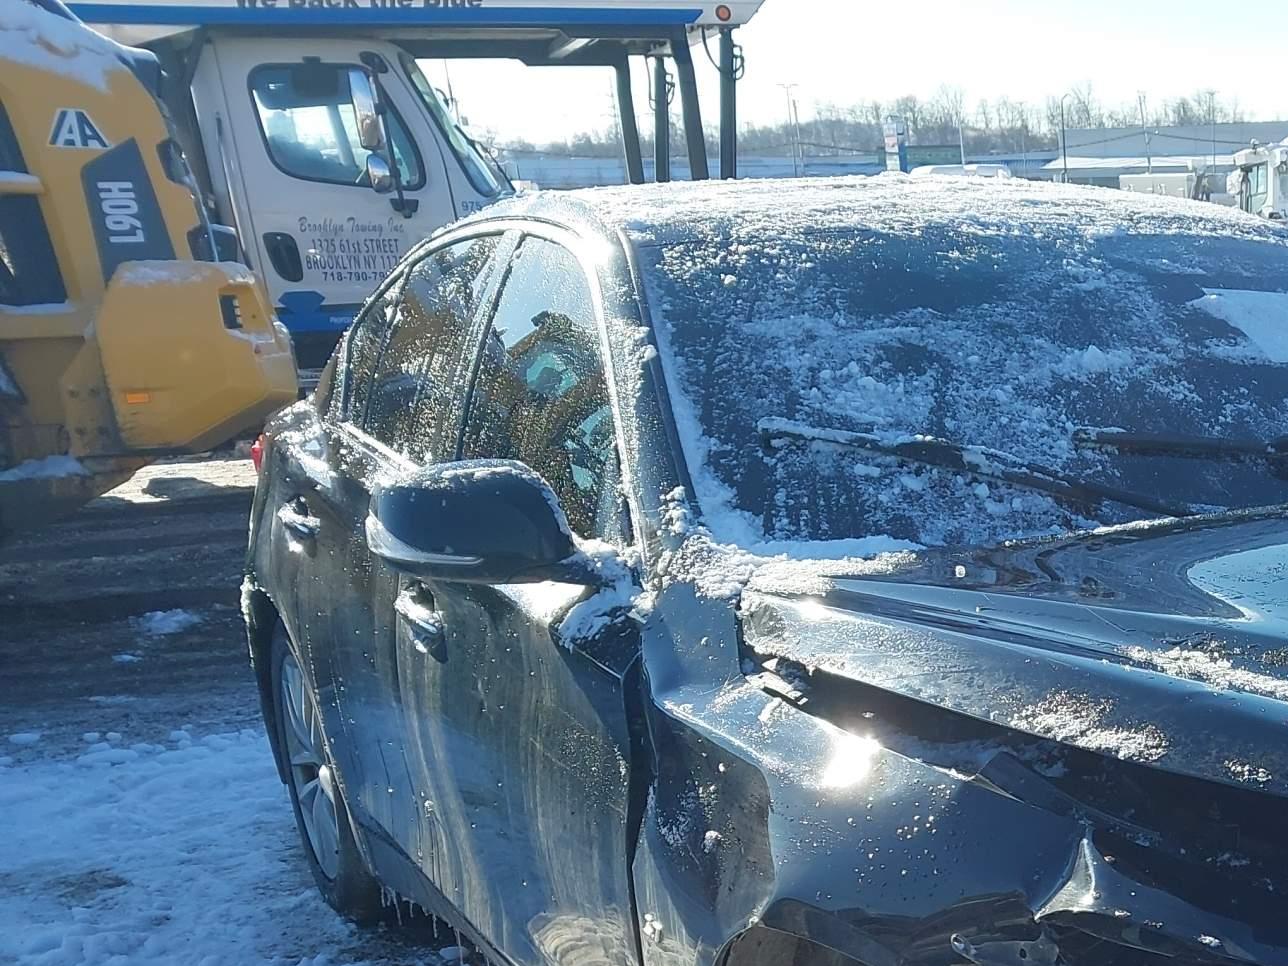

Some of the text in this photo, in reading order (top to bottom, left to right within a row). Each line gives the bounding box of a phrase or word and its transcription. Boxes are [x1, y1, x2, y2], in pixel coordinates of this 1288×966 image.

[298, 216, 344, 236] Brooklyn
[347, 216, 383, 237] Towing
[363, 239, 399, 253] STREET
[306, 255, 361, 270] BROOKLYN
[363, 255, 377, 269] NY
